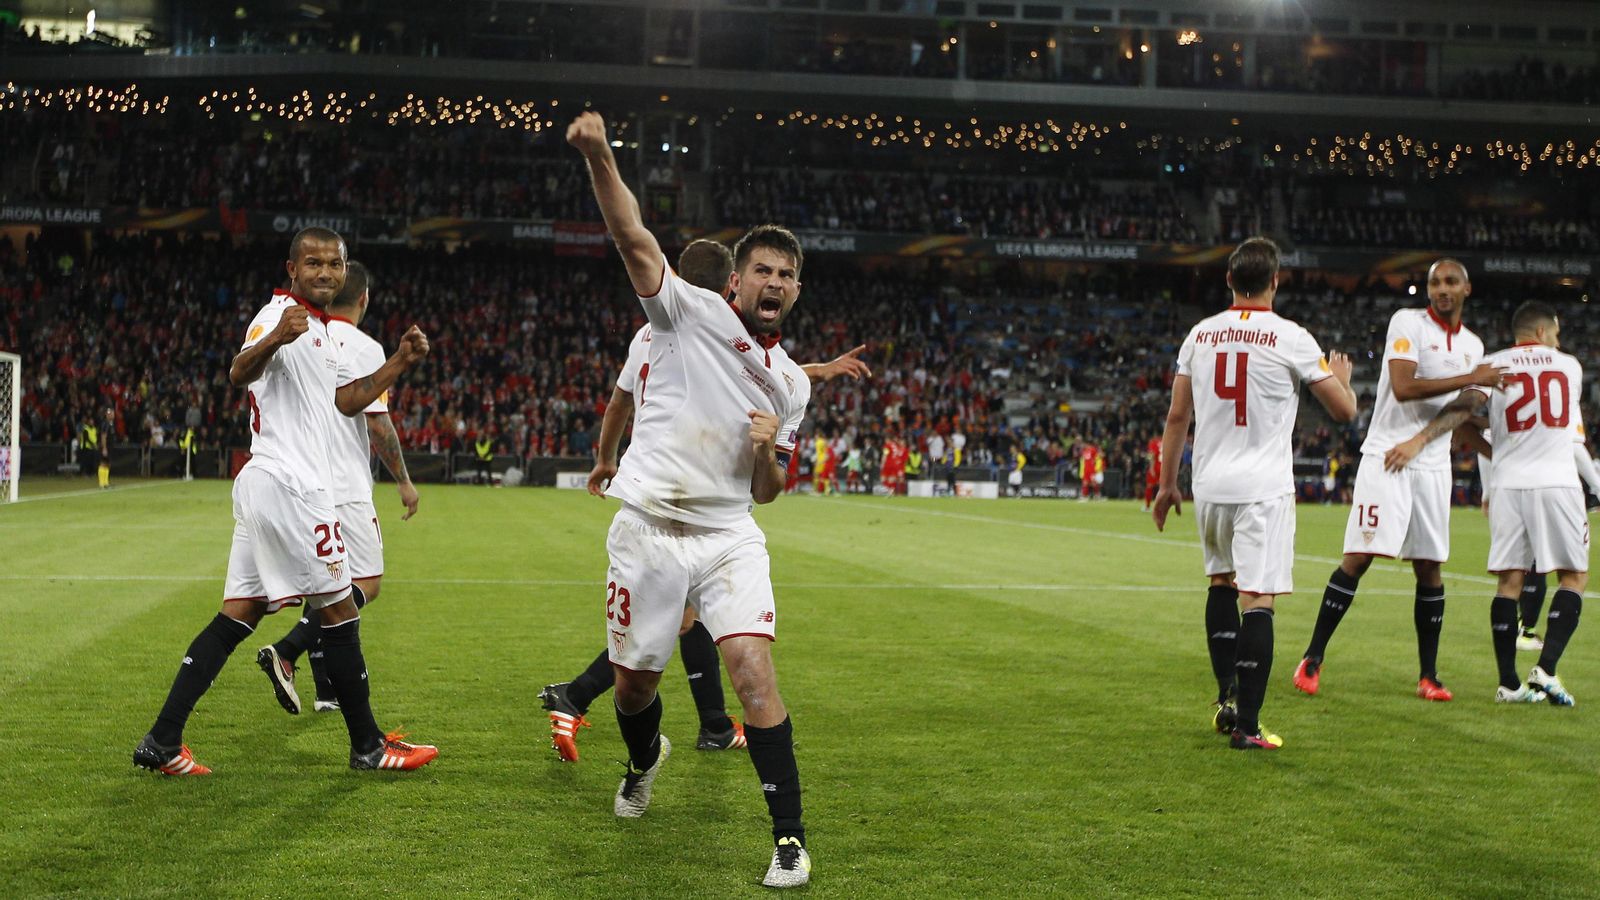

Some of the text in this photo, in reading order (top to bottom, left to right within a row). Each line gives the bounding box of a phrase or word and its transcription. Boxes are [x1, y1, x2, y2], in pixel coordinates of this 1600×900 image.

[46, 208, 102, 224] LEAGUE
[995, 242, 1138, 260] UEFA EUROPA LEAGUE
[1484, 257, 1592, 276] BASEL FINAL 2016
[1213, 352, 1249, 427] 4
[1502, 370, 1570, 433] 20
[1358, 504, 1379, 528] 15
[606, 580, 631, 627] 23
